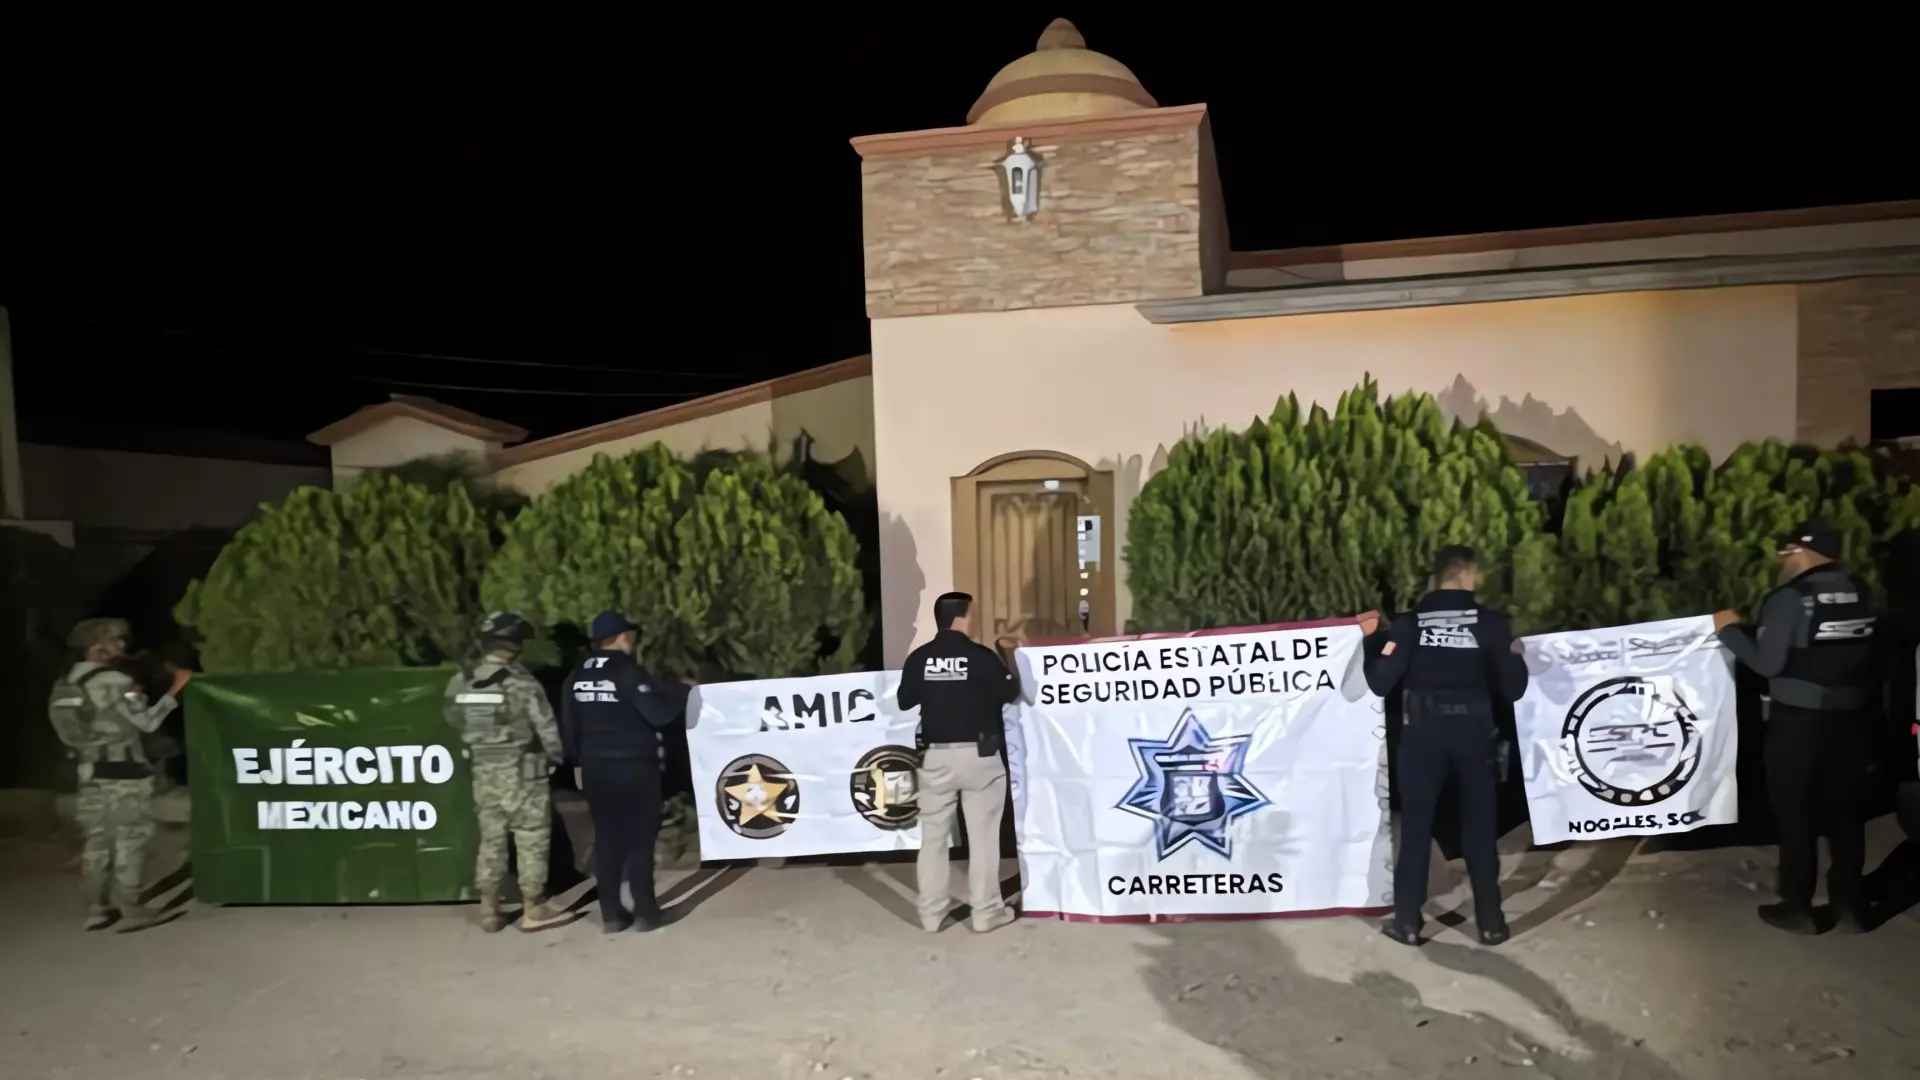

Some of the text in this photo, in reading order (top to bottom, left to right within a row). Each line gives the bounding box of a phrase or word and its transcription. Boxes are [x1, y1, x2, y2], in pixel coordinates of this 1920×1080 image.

[1043, 637, 1328, 675] POLICÍA ESTATAL DE
[1041, 668, 1335, 705] SEGURIDAD PÚBLICA
[760, 688, 876, 732] AMIC
[232, 738, 454, 785] EJÉRCITO
[257, 801, 437, 830] MEXICANO
[1107, 872, 1284, 896] CARRETERAS
